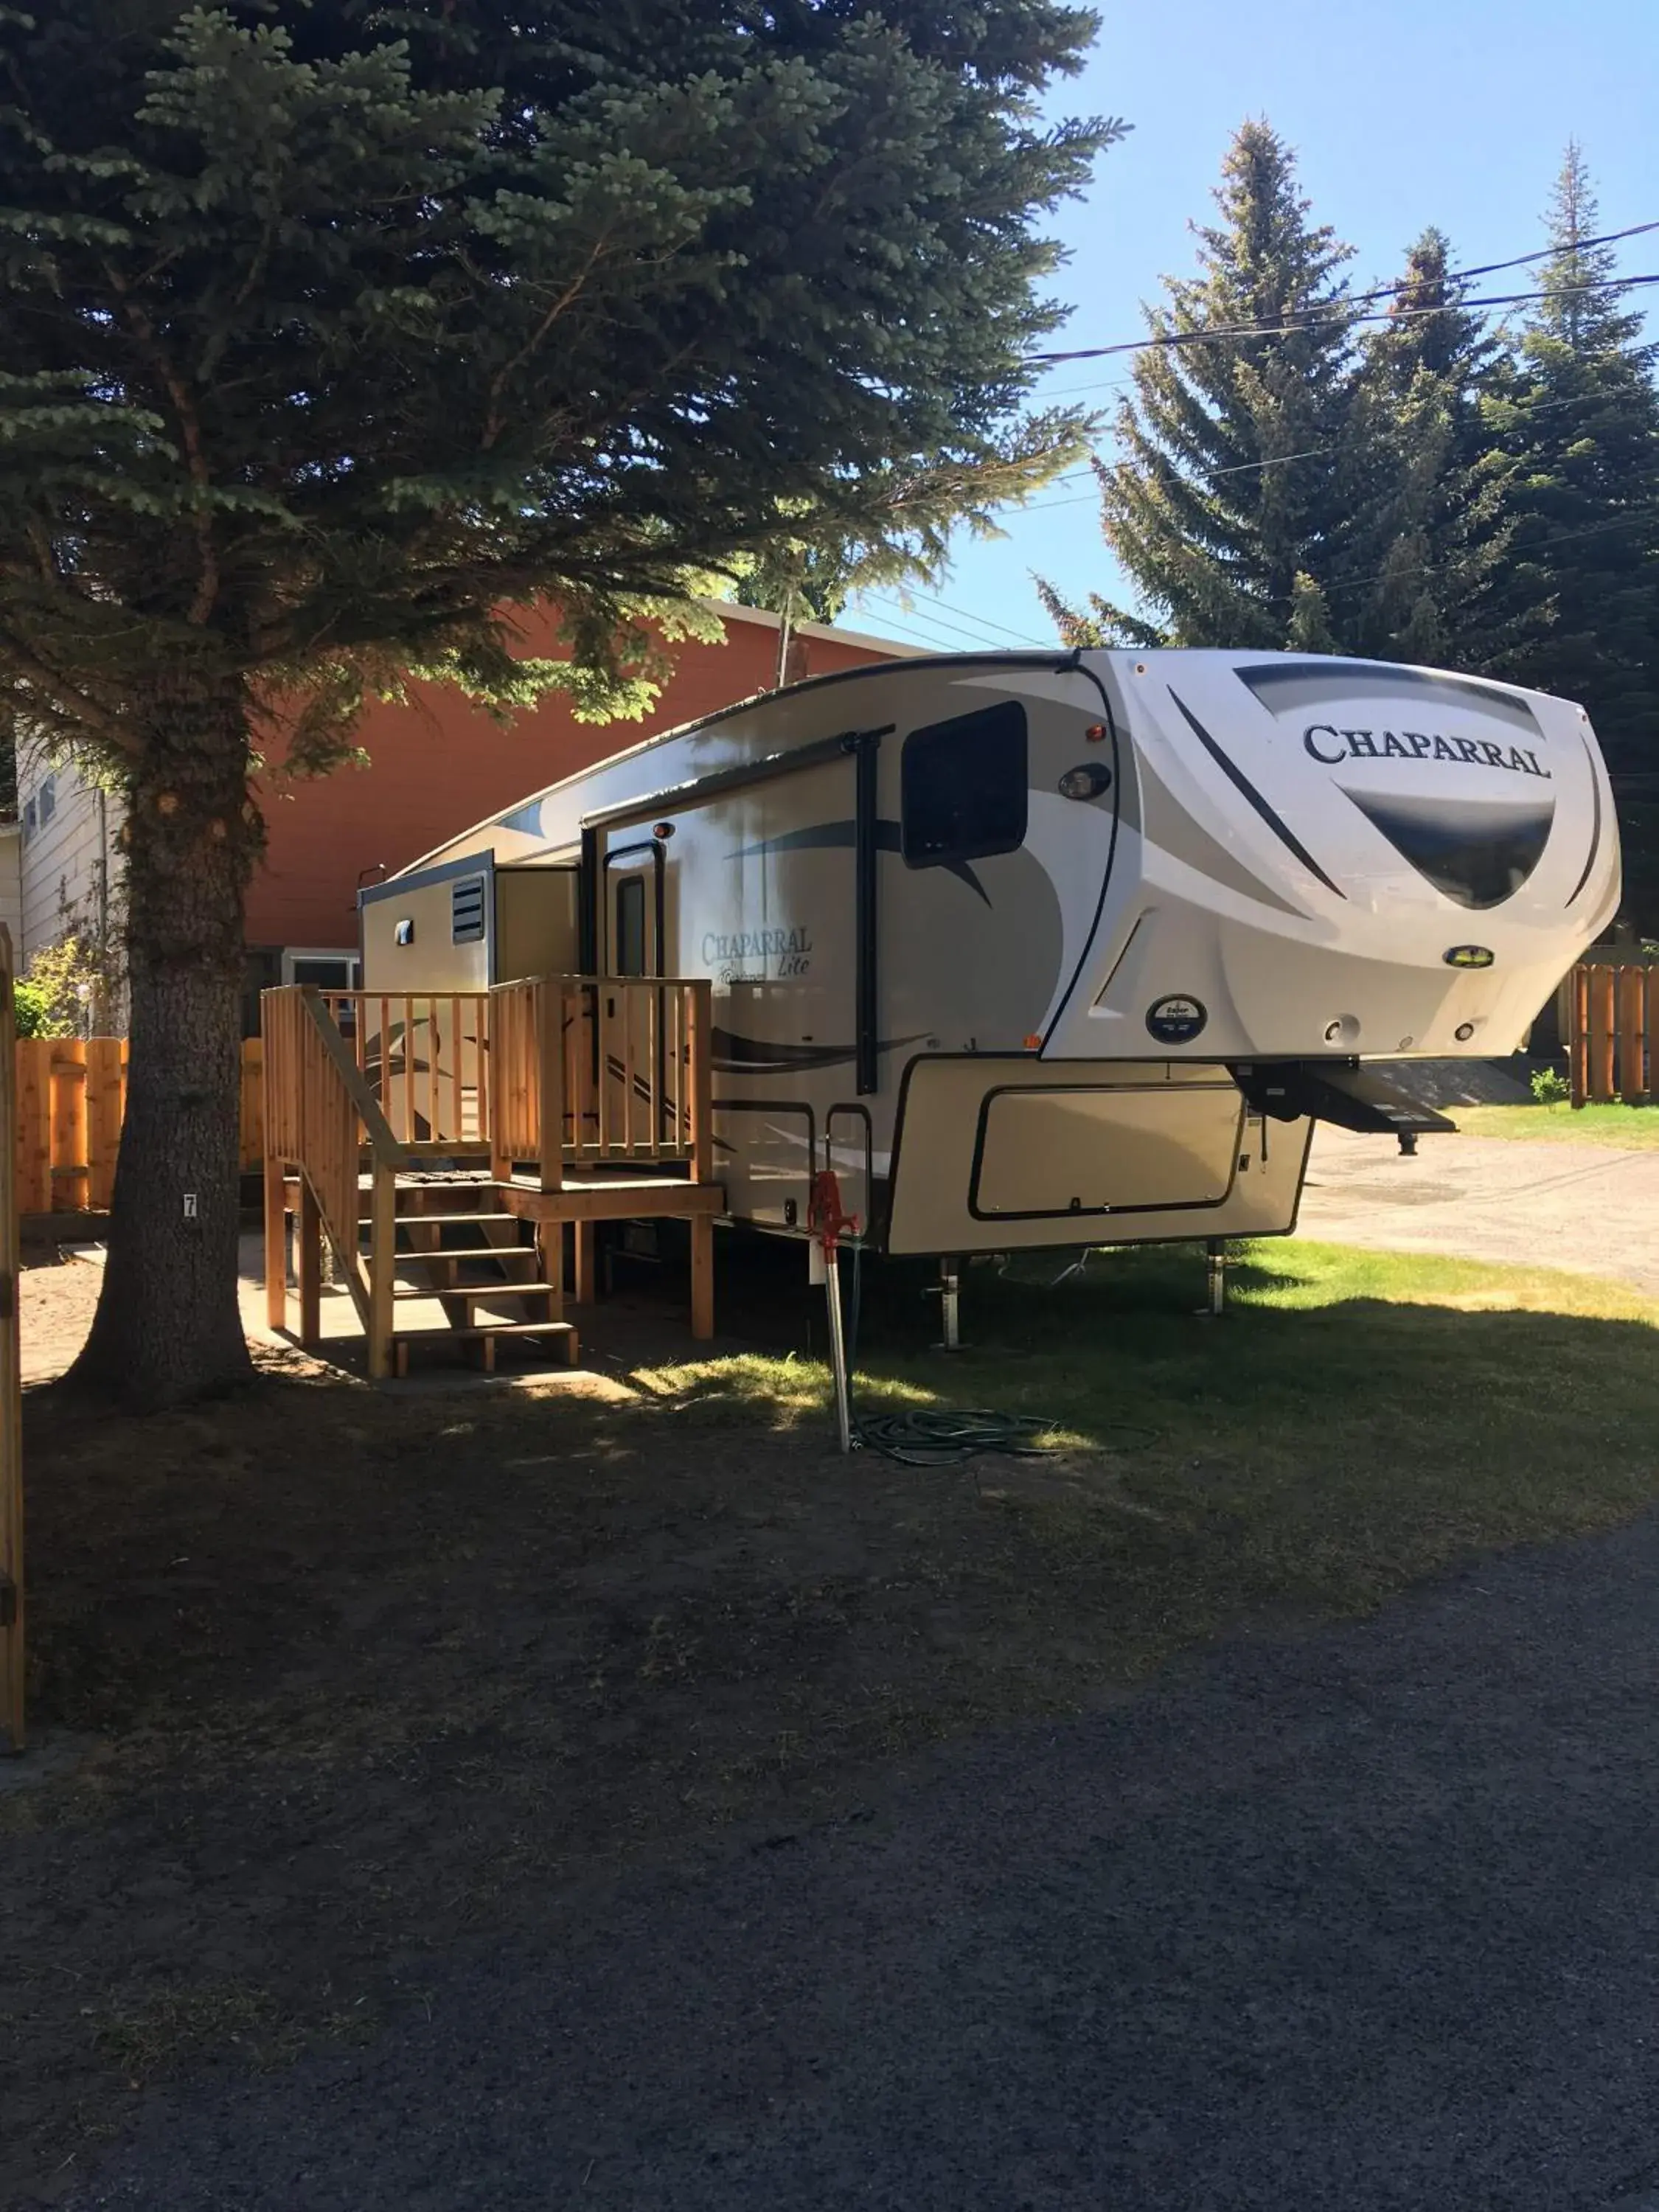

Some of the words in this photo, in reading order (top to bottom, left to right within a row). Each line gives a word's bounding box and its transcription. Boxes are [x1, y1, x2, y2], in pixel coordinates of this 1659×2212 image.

[1303, 724, 1552, 779] CHAPARRAL
[702, 928, 813, 967] CHAPARRAL
[778, 955, 810, 976] Lite
[186, 1196, 195, 1215] 7
